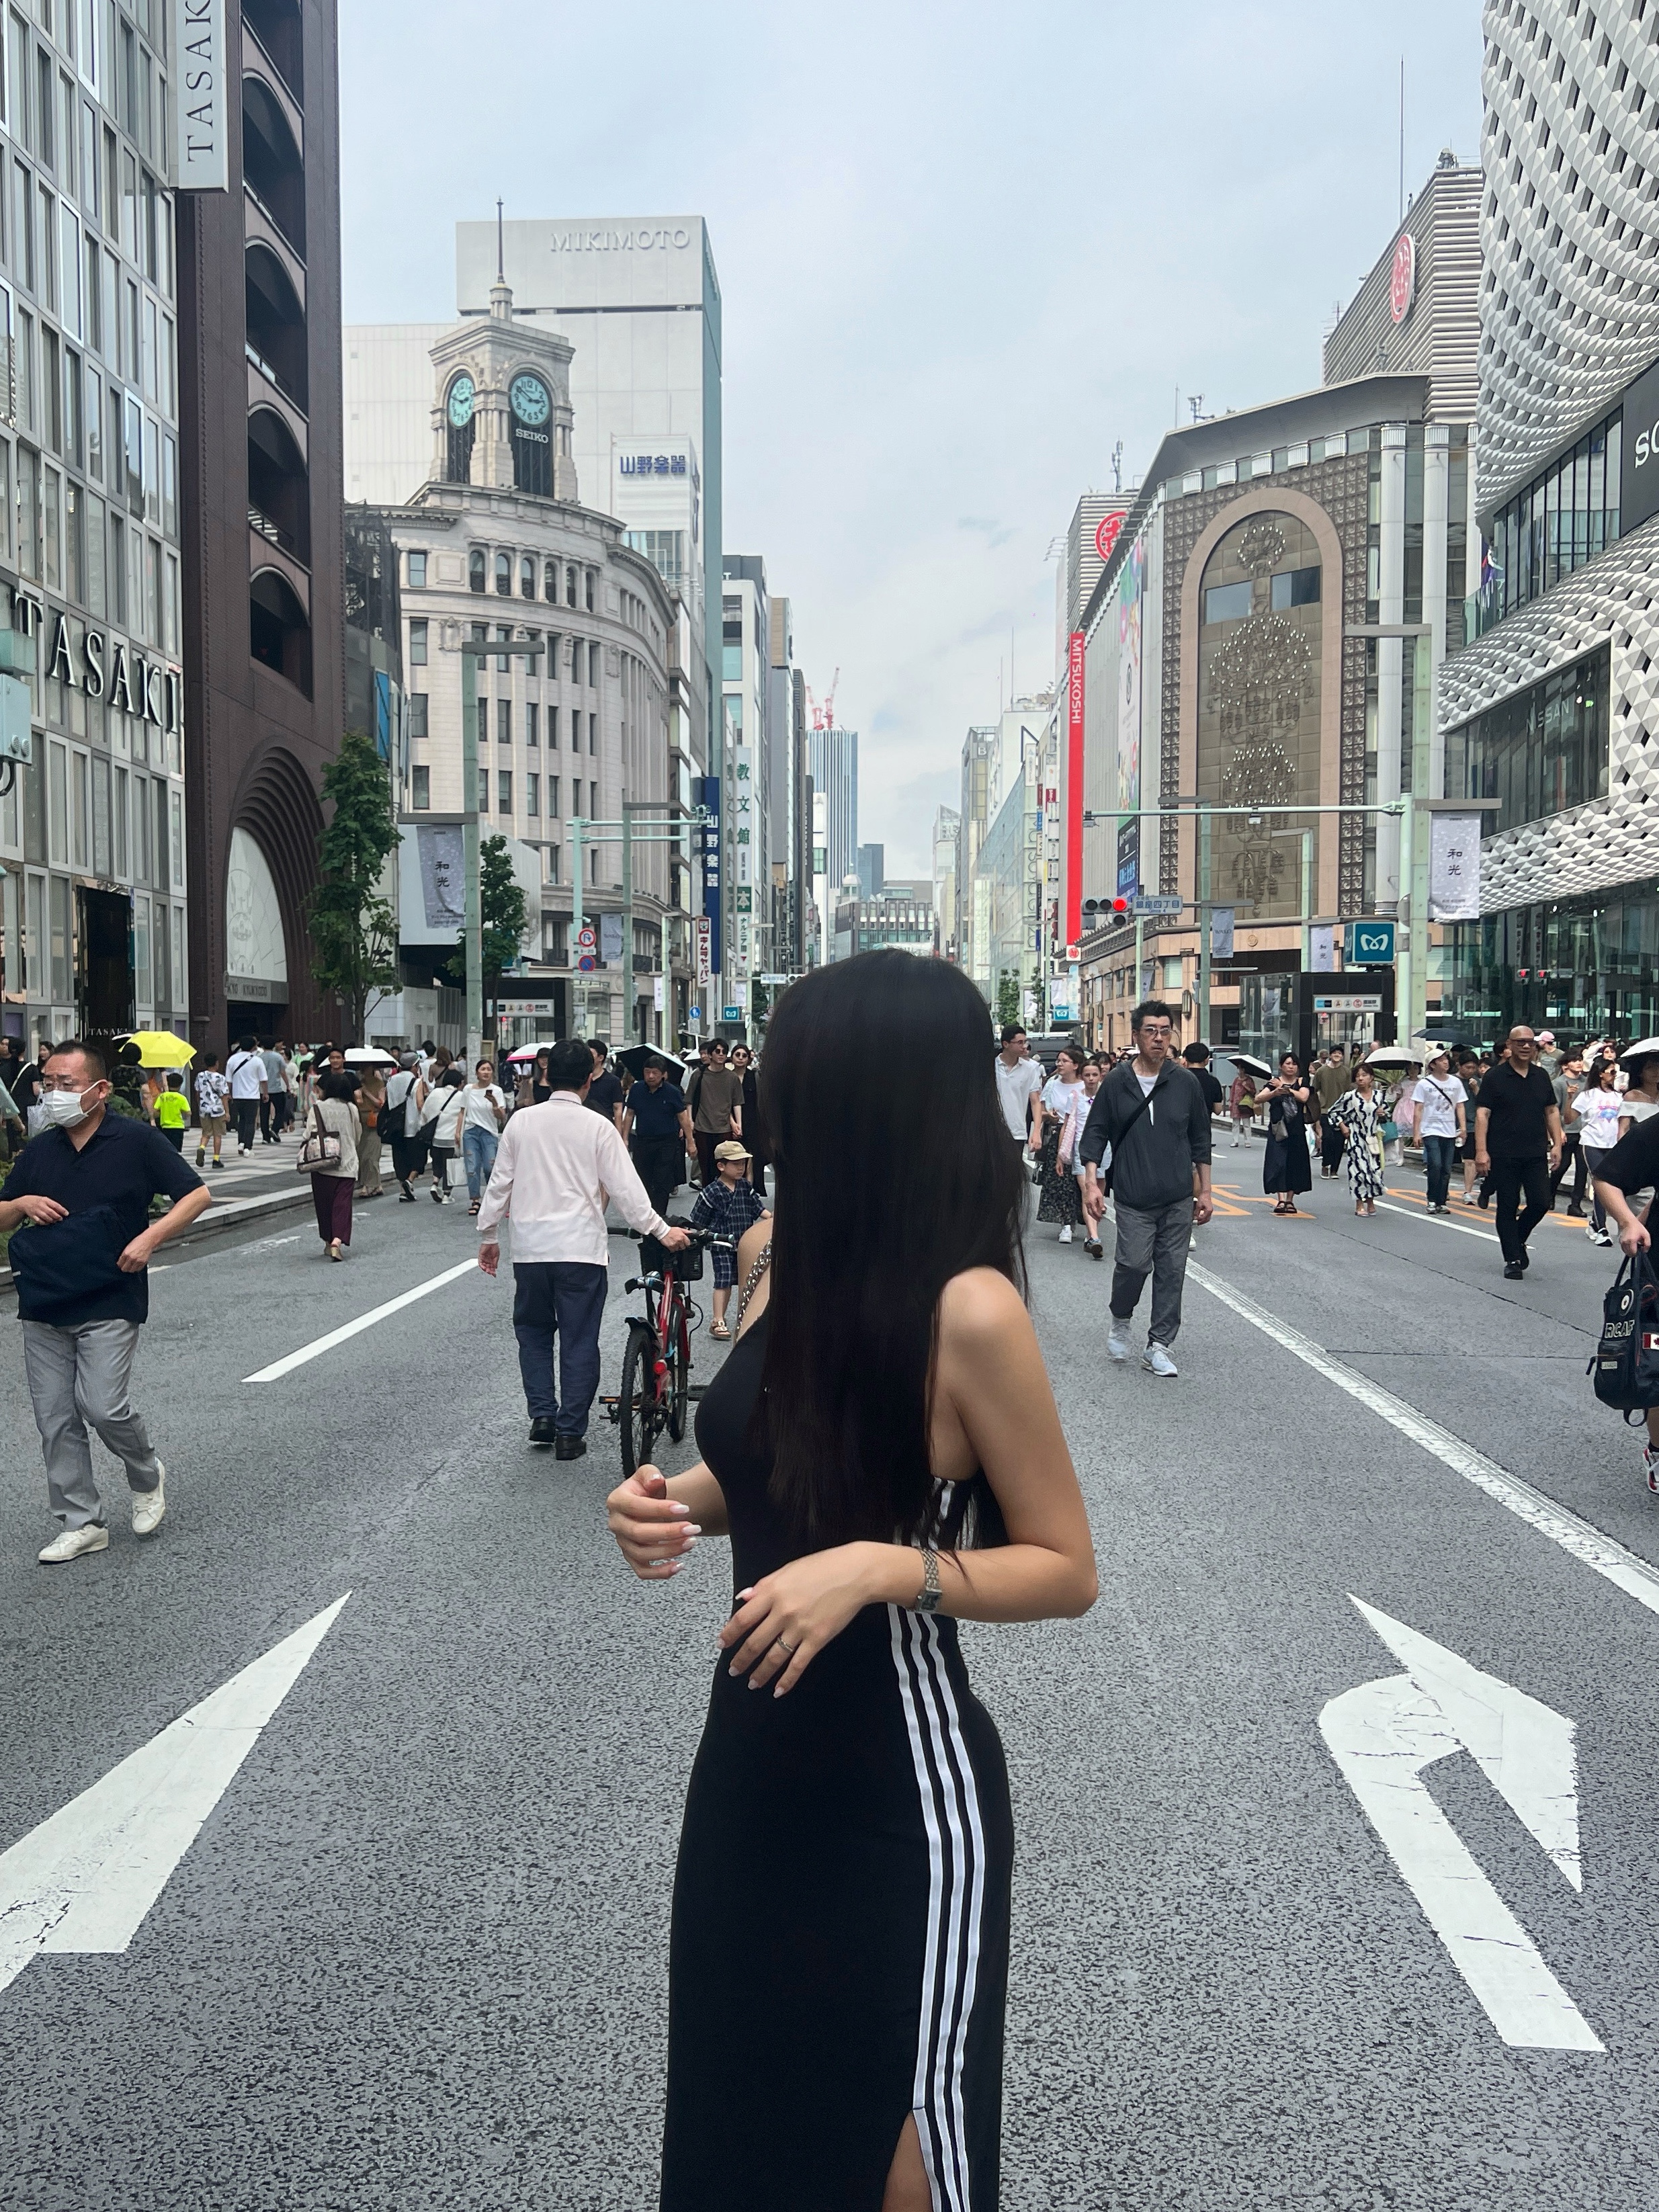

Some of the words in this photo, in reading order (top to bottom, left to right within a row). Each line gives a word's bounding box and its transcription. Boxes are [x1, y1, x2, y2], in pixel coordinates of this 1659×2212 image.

[551, 230, 690, 252] MIKIMOTO
[515, 428, 549, 443] SEIKO
[620, 455, 685, 474] 山野楽器
[13, 591, 179, 734] TASAKI
[1072, 639, 1082, 724] MITSUKOSHI
[1526, 698, 1569, 732] NISSAN
[978, 747, 987, 755] B
[706, 814, 718, 887] 山野楽器
[1447, 849, 1463, 876] 和光
[435, 861, 450, 887] 和光
[738, 890, 750, 909] 本
[700, 937, 709, 984] キムラヤのパン
[1605, 1320, 1635, 1338] RCAF
